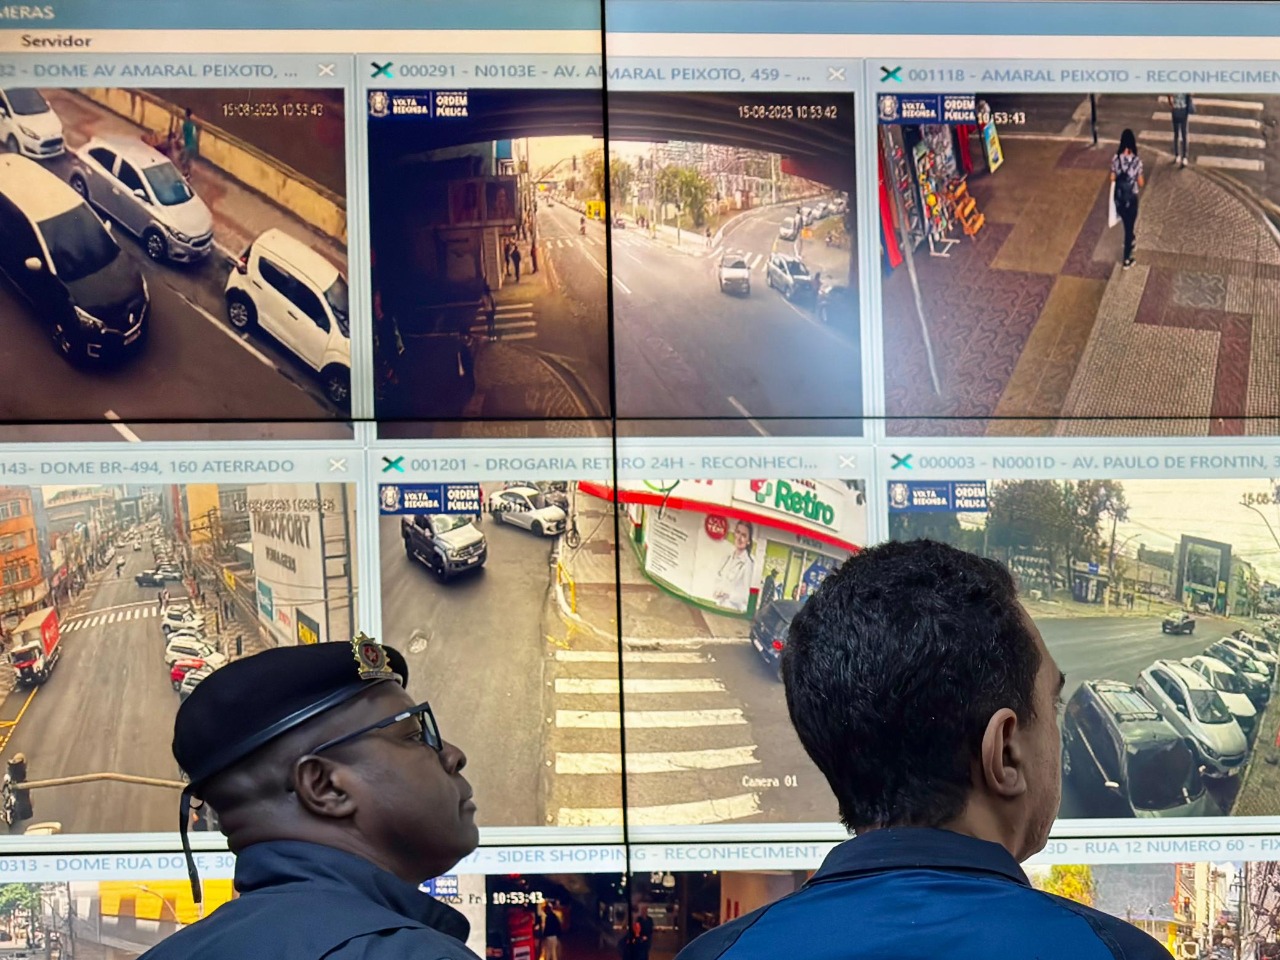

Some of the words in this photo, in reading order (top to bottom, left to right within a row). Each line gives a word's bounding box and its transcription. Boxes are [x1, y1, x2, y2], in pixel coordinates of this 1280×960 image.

[22, 34, 92, 48] Servidor
[34, 64, 88, 77] DOME
[93, 64, 116, 77] AV
[121, 64, 197, 78] AMARAL
[203, 64, 277, 79] PEIXOTO,
[399, 65, 456, 78] 000291
[475, 65, 536, 79] N0103E
[554, 65, 583, 79] AV.
[588, 65, 666, 81] AMARAL
[671, 67, 745, 83] PEIXOTO,
[751, 68, 779, 82] 459
[908, 69, 965, 83] 001118
[982, 69, 1054, 83] AMARAL
[1061, 70, 1129, 84] PEIXOTO
[41, 462, 95, 475] DOME
[100, 461, 164, 476] BR-494,
[171, 461, 198, 474] 160
[202, 460, 294, 473] ATERRADO
[411, 458, 467, 472] 001201
[486, 457, 576, 471] DROGARIA
[582, 456, 646, 470] RETIRO
[651, 456, 684, 470] 24H
[919, 456, 975, 470] 000003
[993, 456, 1055, 470] N0001D
[1072, 456, 1099, 470] AV.
[1103, 456, 1159, 470] PAULO
[1164, 456, 1186, 470] DE
[1190, 455, 1268, 471] FRONTIN,
[775, 479, 835, 526] Retiro
[784, 775, 798, 788] 01
[1085, 842, 1120, 854] RUA
[1126, 841, 1142, 853] 12
[1147, 839, 1221, 853] NUMERO
[1227, 839, 1244, 852] 60
[497, 850, 545, 863] SIDER
[550, 847, 646, 862] SHOPPING
[56, 858, 110, 872] DOME
[117, 857, 153, 871] RUA
[492, 891, 544, 905] 10:53:43
